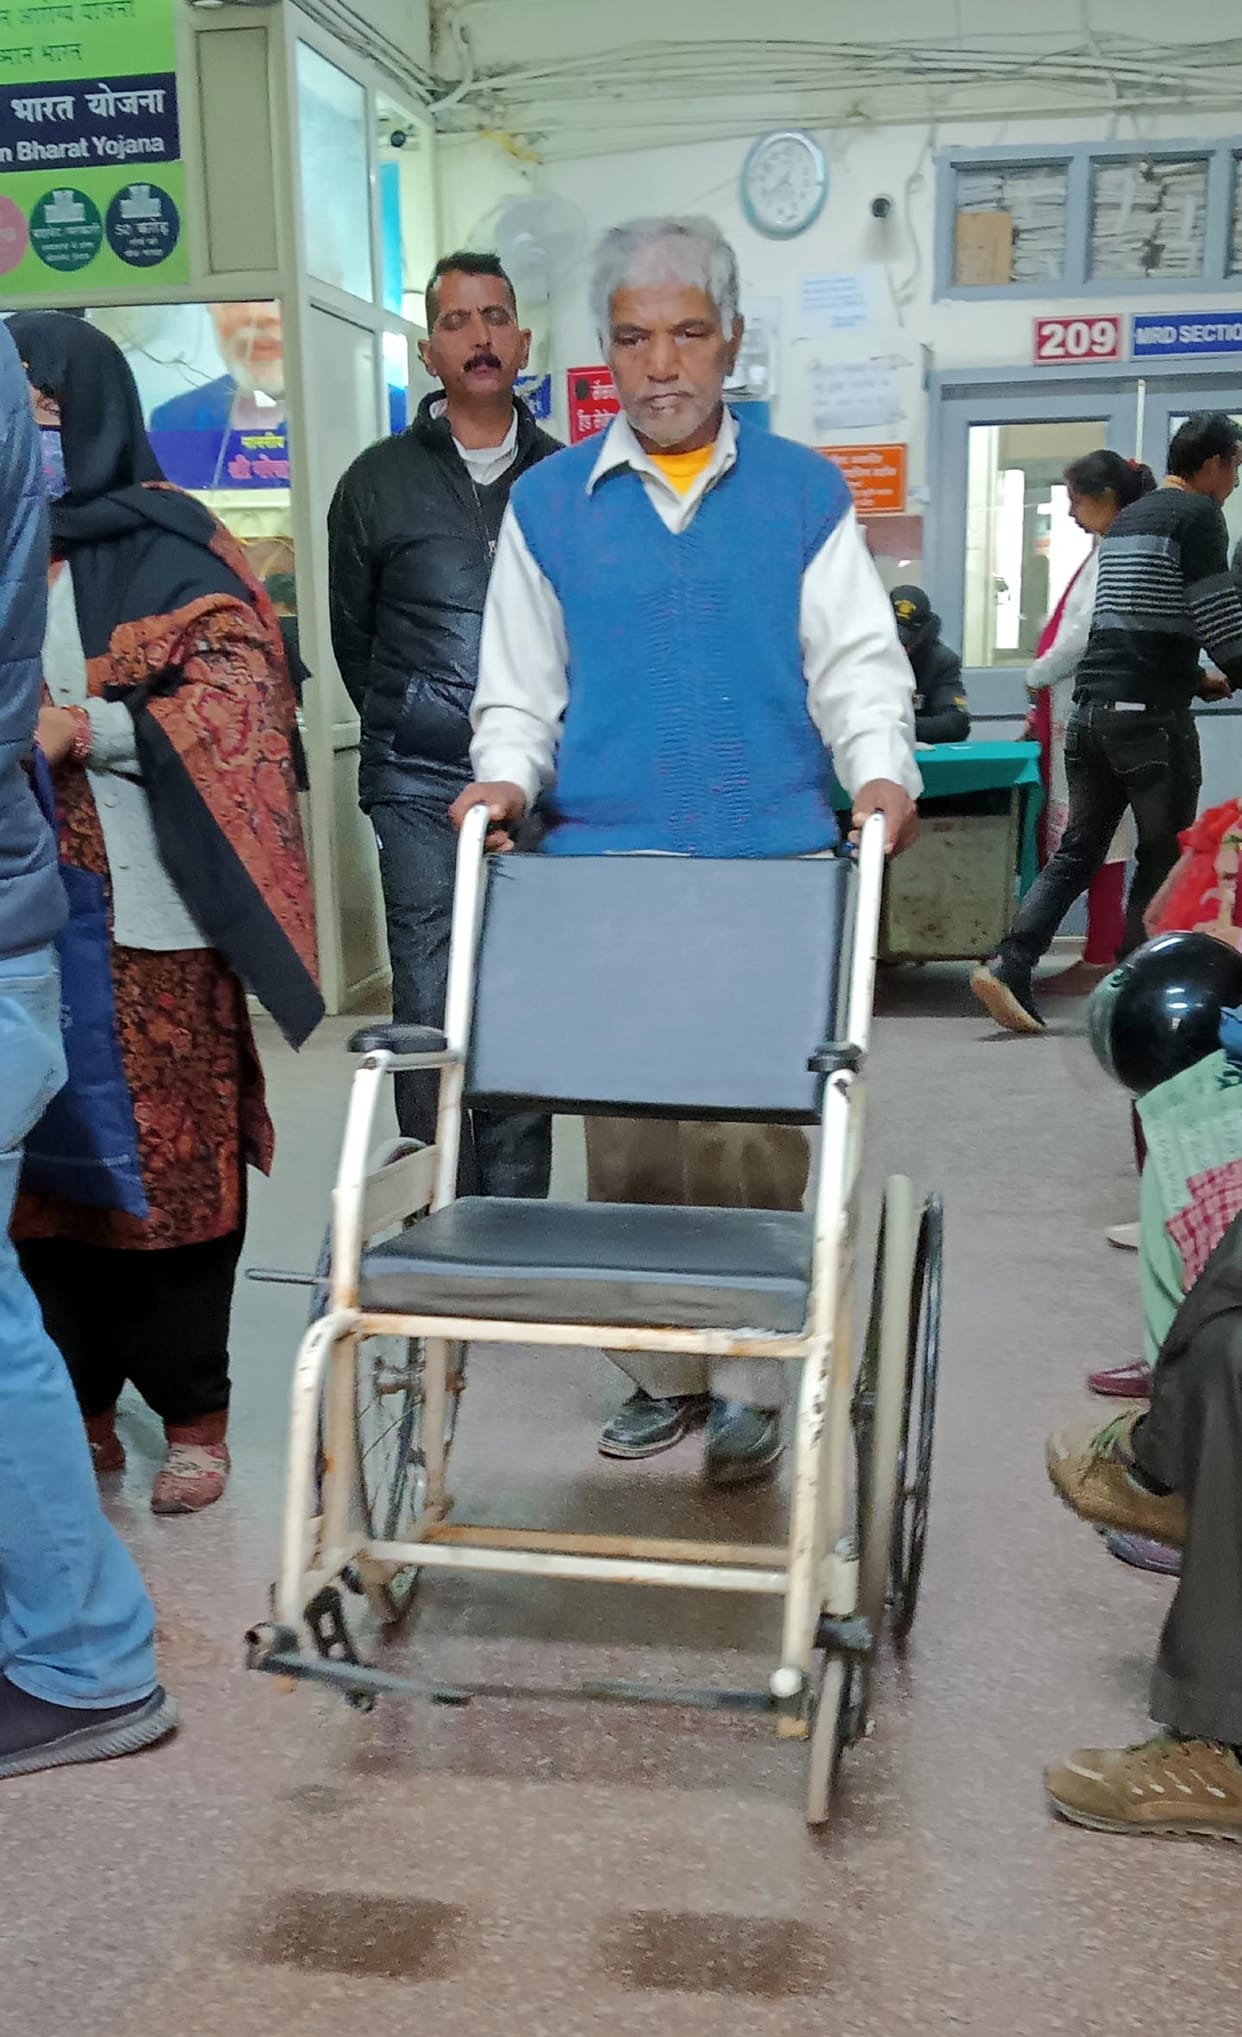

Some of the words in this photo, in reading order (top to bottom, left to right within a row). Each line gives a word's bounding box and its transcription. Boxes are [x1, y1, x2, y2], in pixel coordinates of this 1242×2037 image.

[11, 96, 76, 122] भारत
[84, 82, 167, 118] योजना
[16, 137, 91, 162] Bharat
[91, 134, 165, 159] Yojana
[1039, 320, 1117, 358] 209
[1136, 326, 1178, 345] MRD
